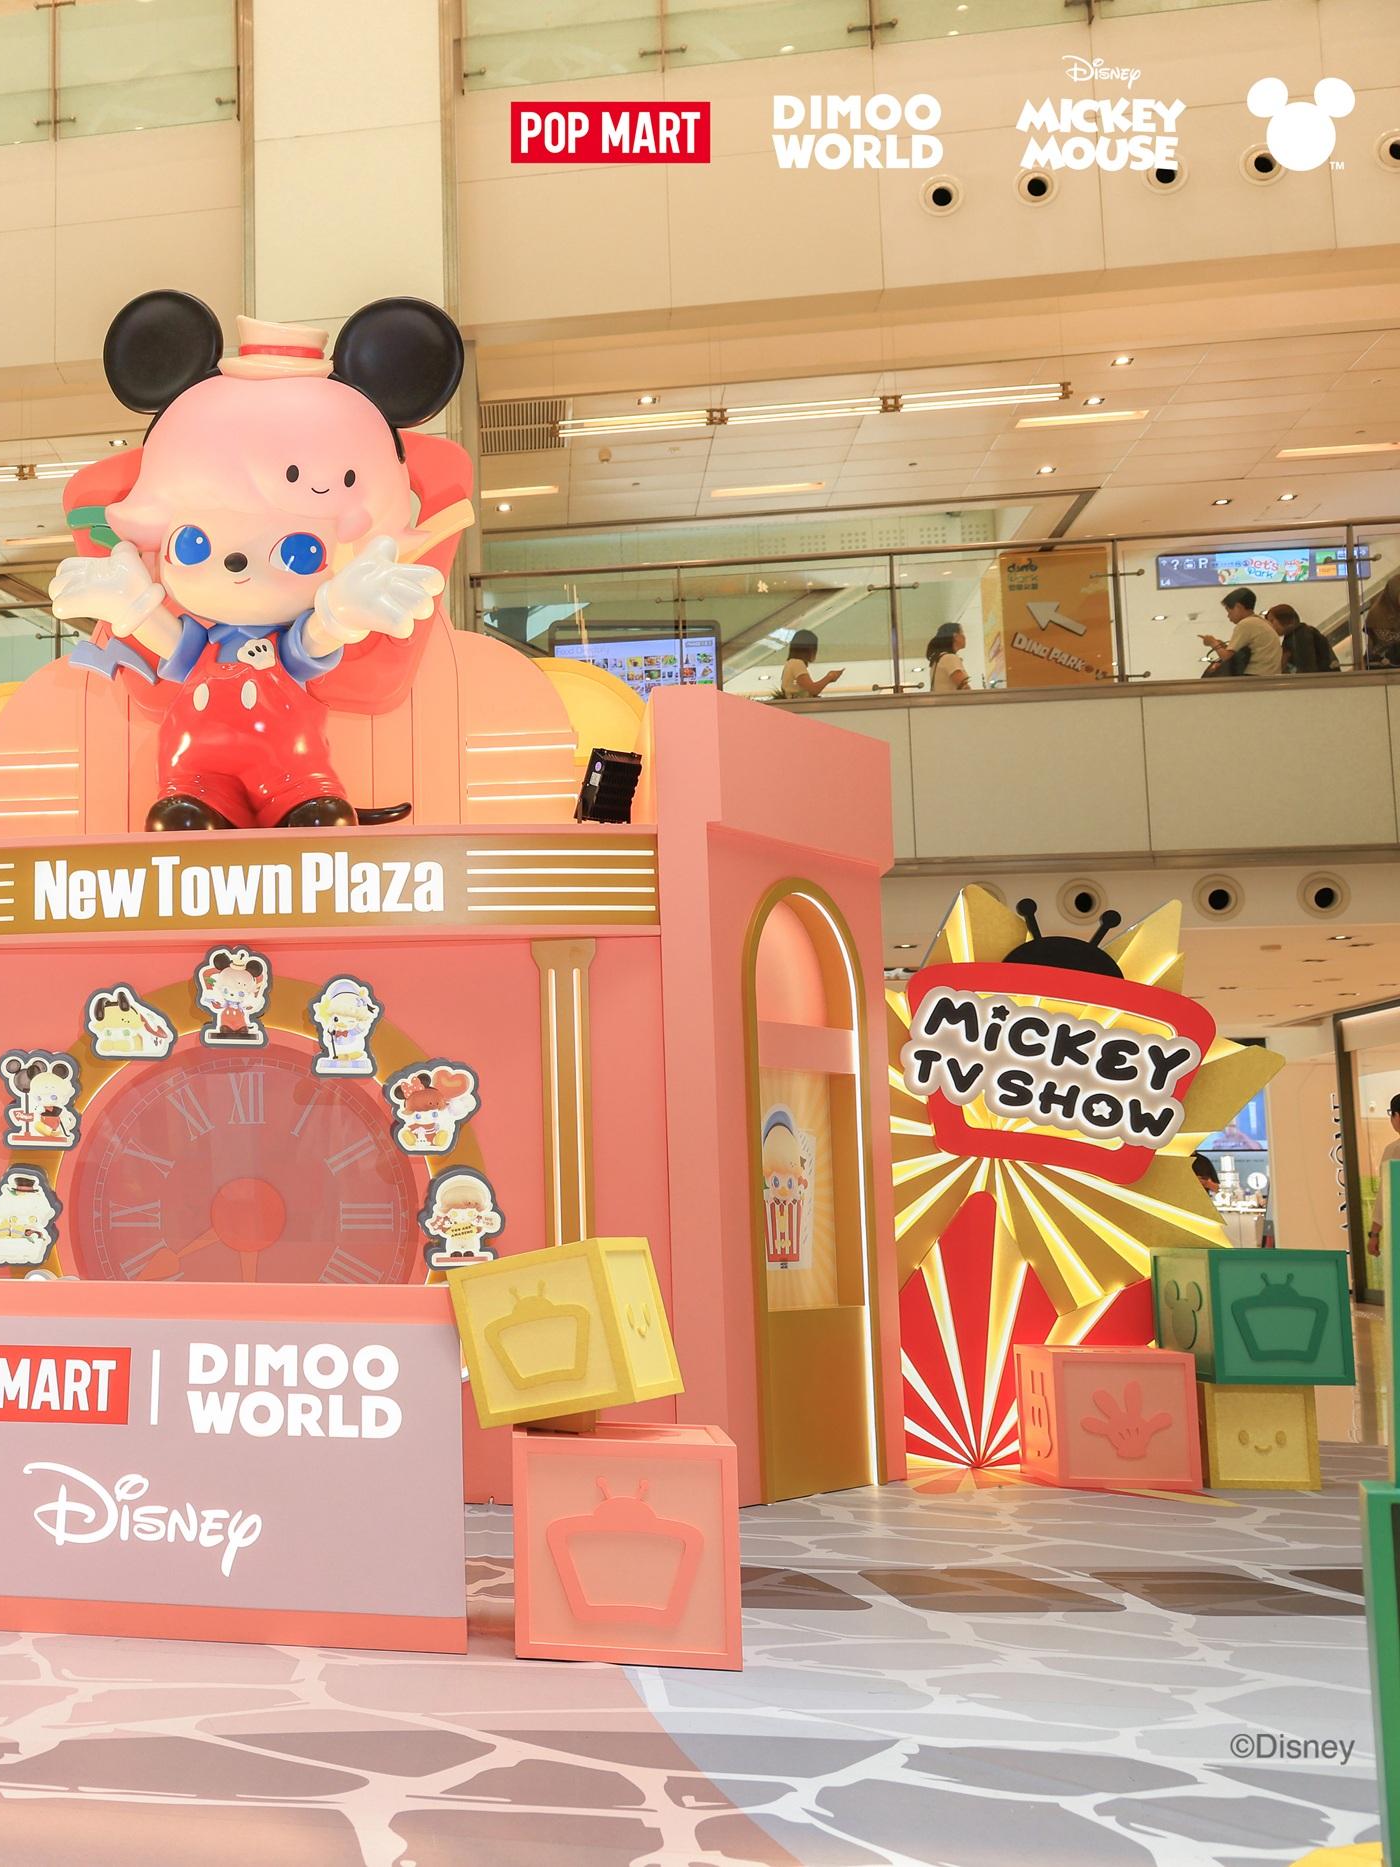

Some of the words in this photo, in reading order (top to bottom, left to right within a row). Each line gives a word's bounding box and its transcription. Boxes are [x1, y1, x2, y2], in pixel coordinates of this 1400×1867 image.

[33, 859, 146, 920] New
[151, 855, 292, 918] Town
[301, 852, 445, 915] Plaza
[912, 1049, 984, 1094] TV
[997, 1070, 1175, 1137] SHOW
[187, 1342, 400, 1391] DIMOO
[187, 1390, 402, 1440] WORLD
[22, 1461, 263, 1577] Disney
